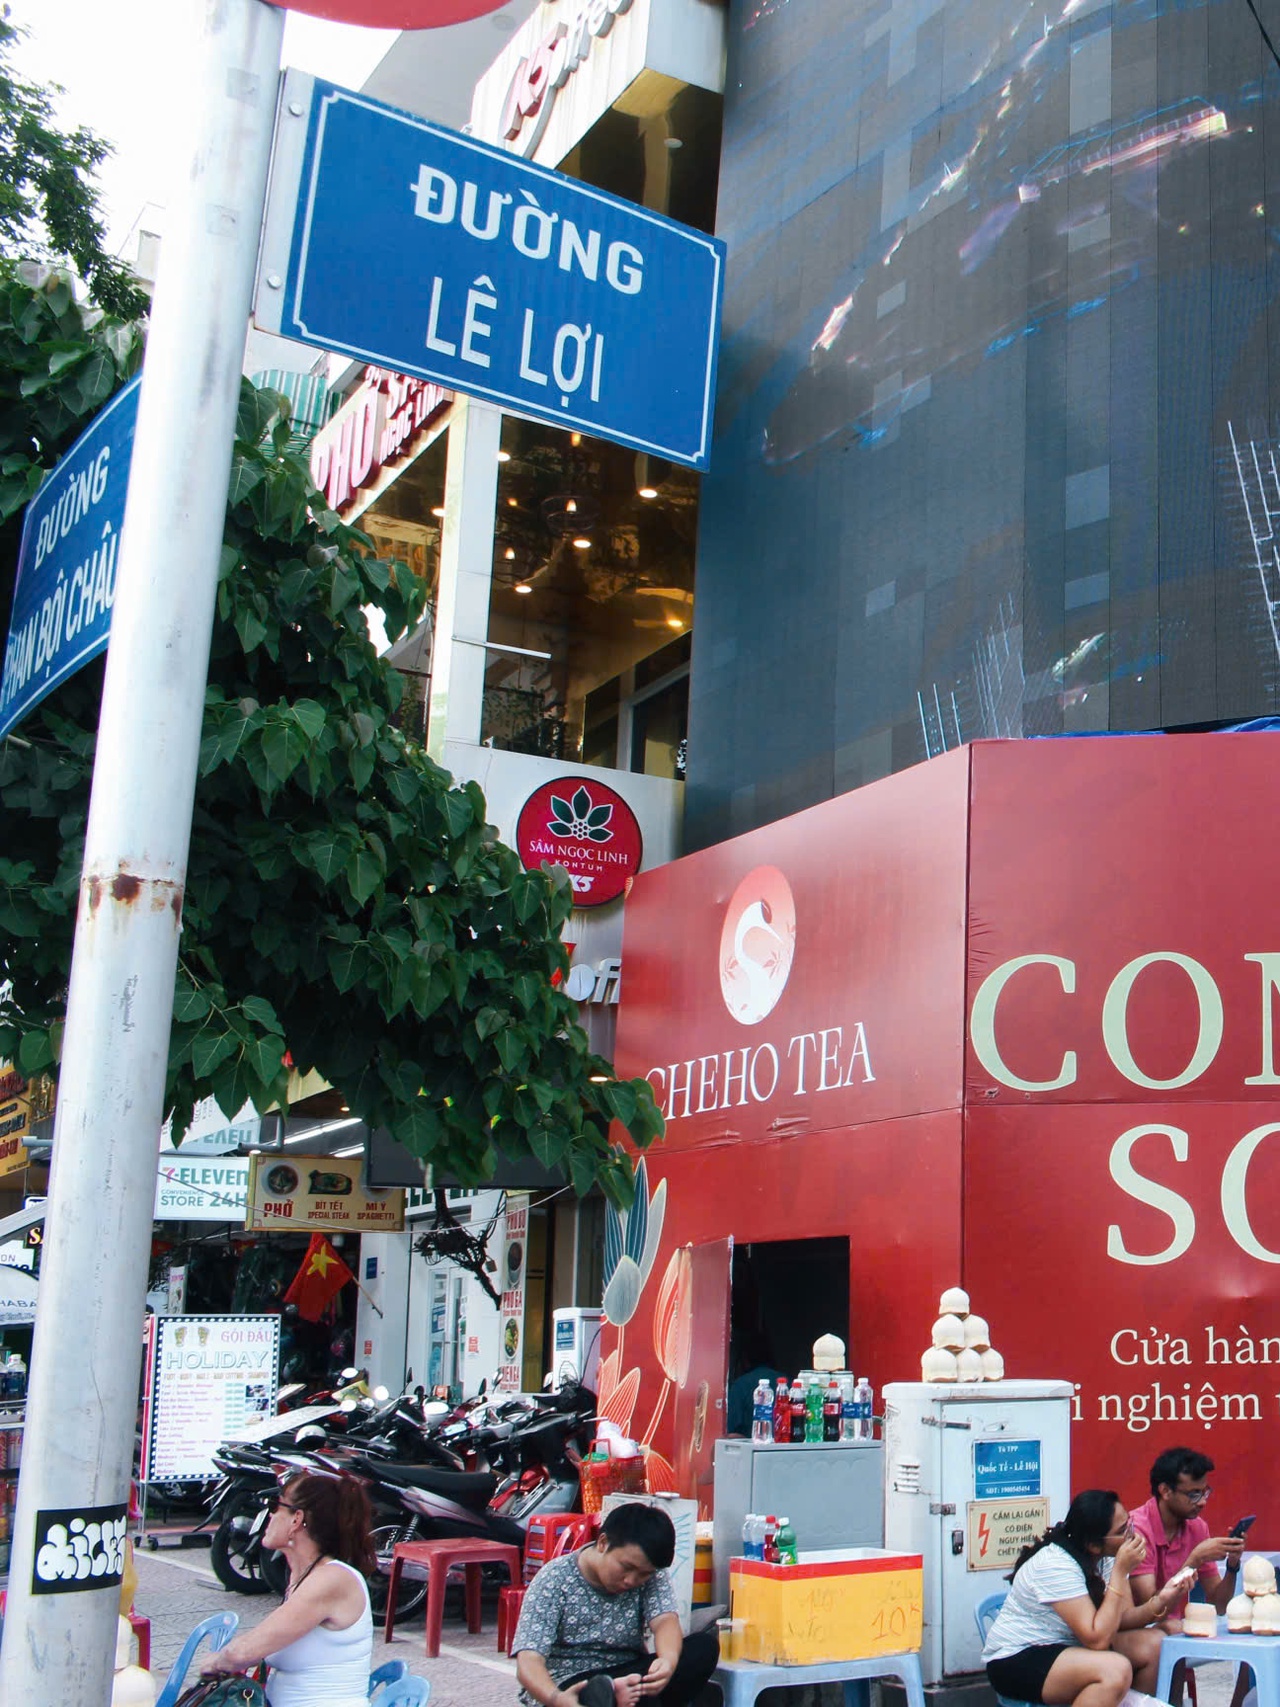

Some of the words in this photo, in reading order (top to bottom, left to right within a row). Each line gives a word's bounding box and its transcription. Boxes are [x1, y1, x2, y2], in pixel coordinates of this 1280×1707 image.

[411, 163, 645, 295] ĐƯỜNG
[424, 275, 498, 370] LÊ
[518, 307, 604, 408] LỢI
[34, 446, 110, 571] ĐƯỜNG
[2, 610, 39, 705] PHAN
[34, 568, 69, 678] BỘI
[65, 521, 117, 642] CHÂU
[529, 840, 554, 855] SÂM
[558, 845, 594, 861] NGỌC
[597, 851, 628, 864] LINH
[555, 859, 603, 871] KONTUM
[645, 1042, 779, 1121] CHEHO
[788, 1021, 877, 1096] TEA
[161, 1195, 204, 1206] STORE
[209, 1191, 247, 1208] 24H
[264, 1199, 293, 1218] PHỞ
[357, 1212, 395, 1220] SPAGHETTI
[1110, 1326, 1192, 1366] Cửa
[166, 1350, 269, 1370] HOLIDAY
[1098, 1382, 1263, 1432] nghiệm
[1007, 1445, 1018, 1453] TPP
[977, 1461, 996, 1474] Quốc
[999, 1461, 1008, 1472] Tế
[1014, 1460, 1024, 1471] Lễ
[1025, 1461, 1038, 1472] Hội
[992, 1509, 1010, 1521] CẤM
[1005, 1524, 1015, 1533] CÓ
[1016, 1523, 1032, 1533] ĐIỆN
[999, 1536, 1018, 1545] NGUY
[997, 1546, 1015, 1557] CHẾT
